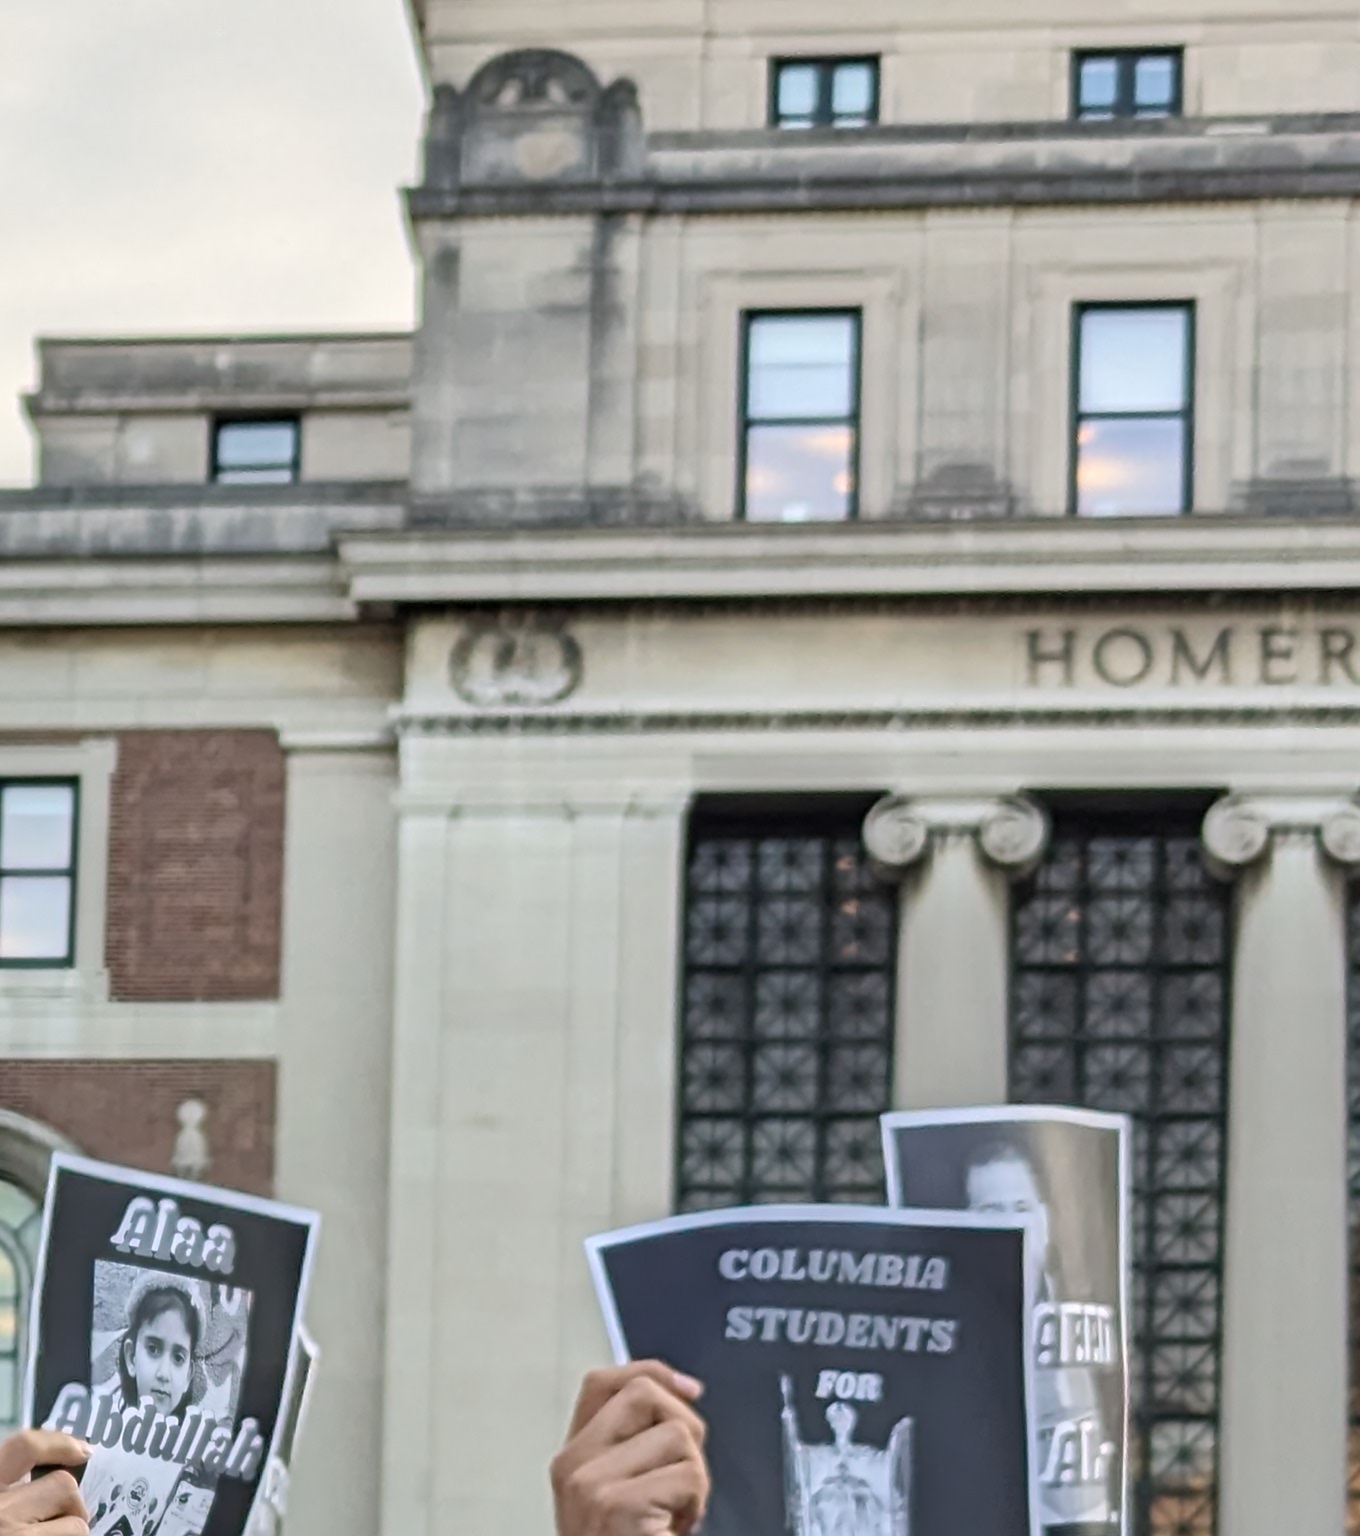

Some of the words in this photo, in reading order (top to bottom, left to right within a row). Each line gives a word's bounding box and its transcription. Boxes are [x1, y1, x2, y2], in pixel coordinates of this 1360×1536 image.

[1023, 625, 1360, 689] HOMER
[109, 1195, 236, 1275] Alaa
[718, 1248, 950, 1290] COLUMBIA
[724, 1305, 958, 1354] STUDENTS
[815, 1368, 882, 1401] FOR
[42, 1380, 264, 1481] Abdullah
